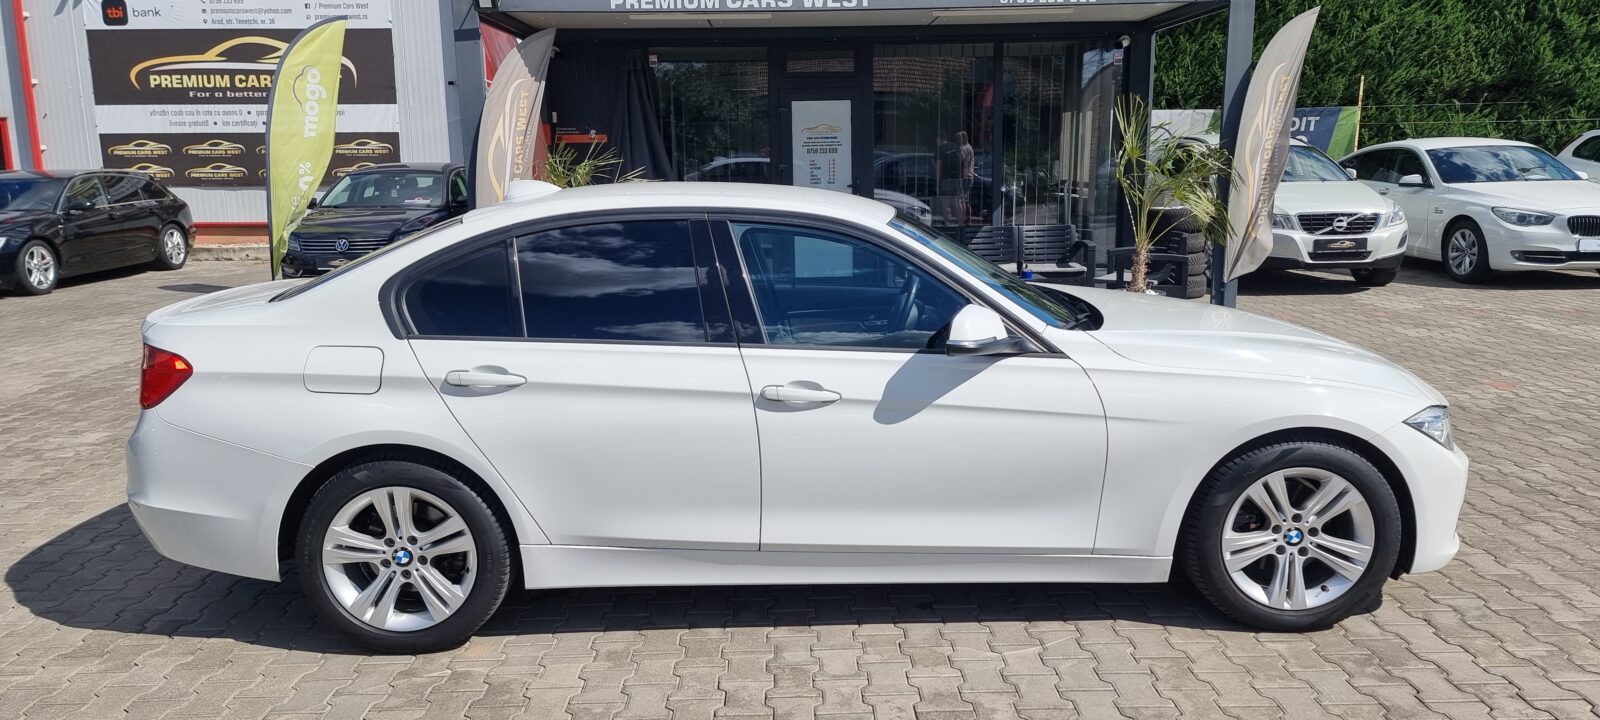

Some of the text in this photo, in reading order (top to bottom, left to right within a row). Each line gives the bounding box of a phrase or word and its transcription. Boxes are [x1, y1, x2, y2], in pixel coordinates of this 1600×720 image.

[106, 7, 161, 18] tbi bank
[149, 74, 231, 88] PREMIUM
[189, 90, 210, 98] For
[226, 90, 268, 98] better
[304, 67, 326, 137] mogo
[516, 90, 529, 131] WEST
